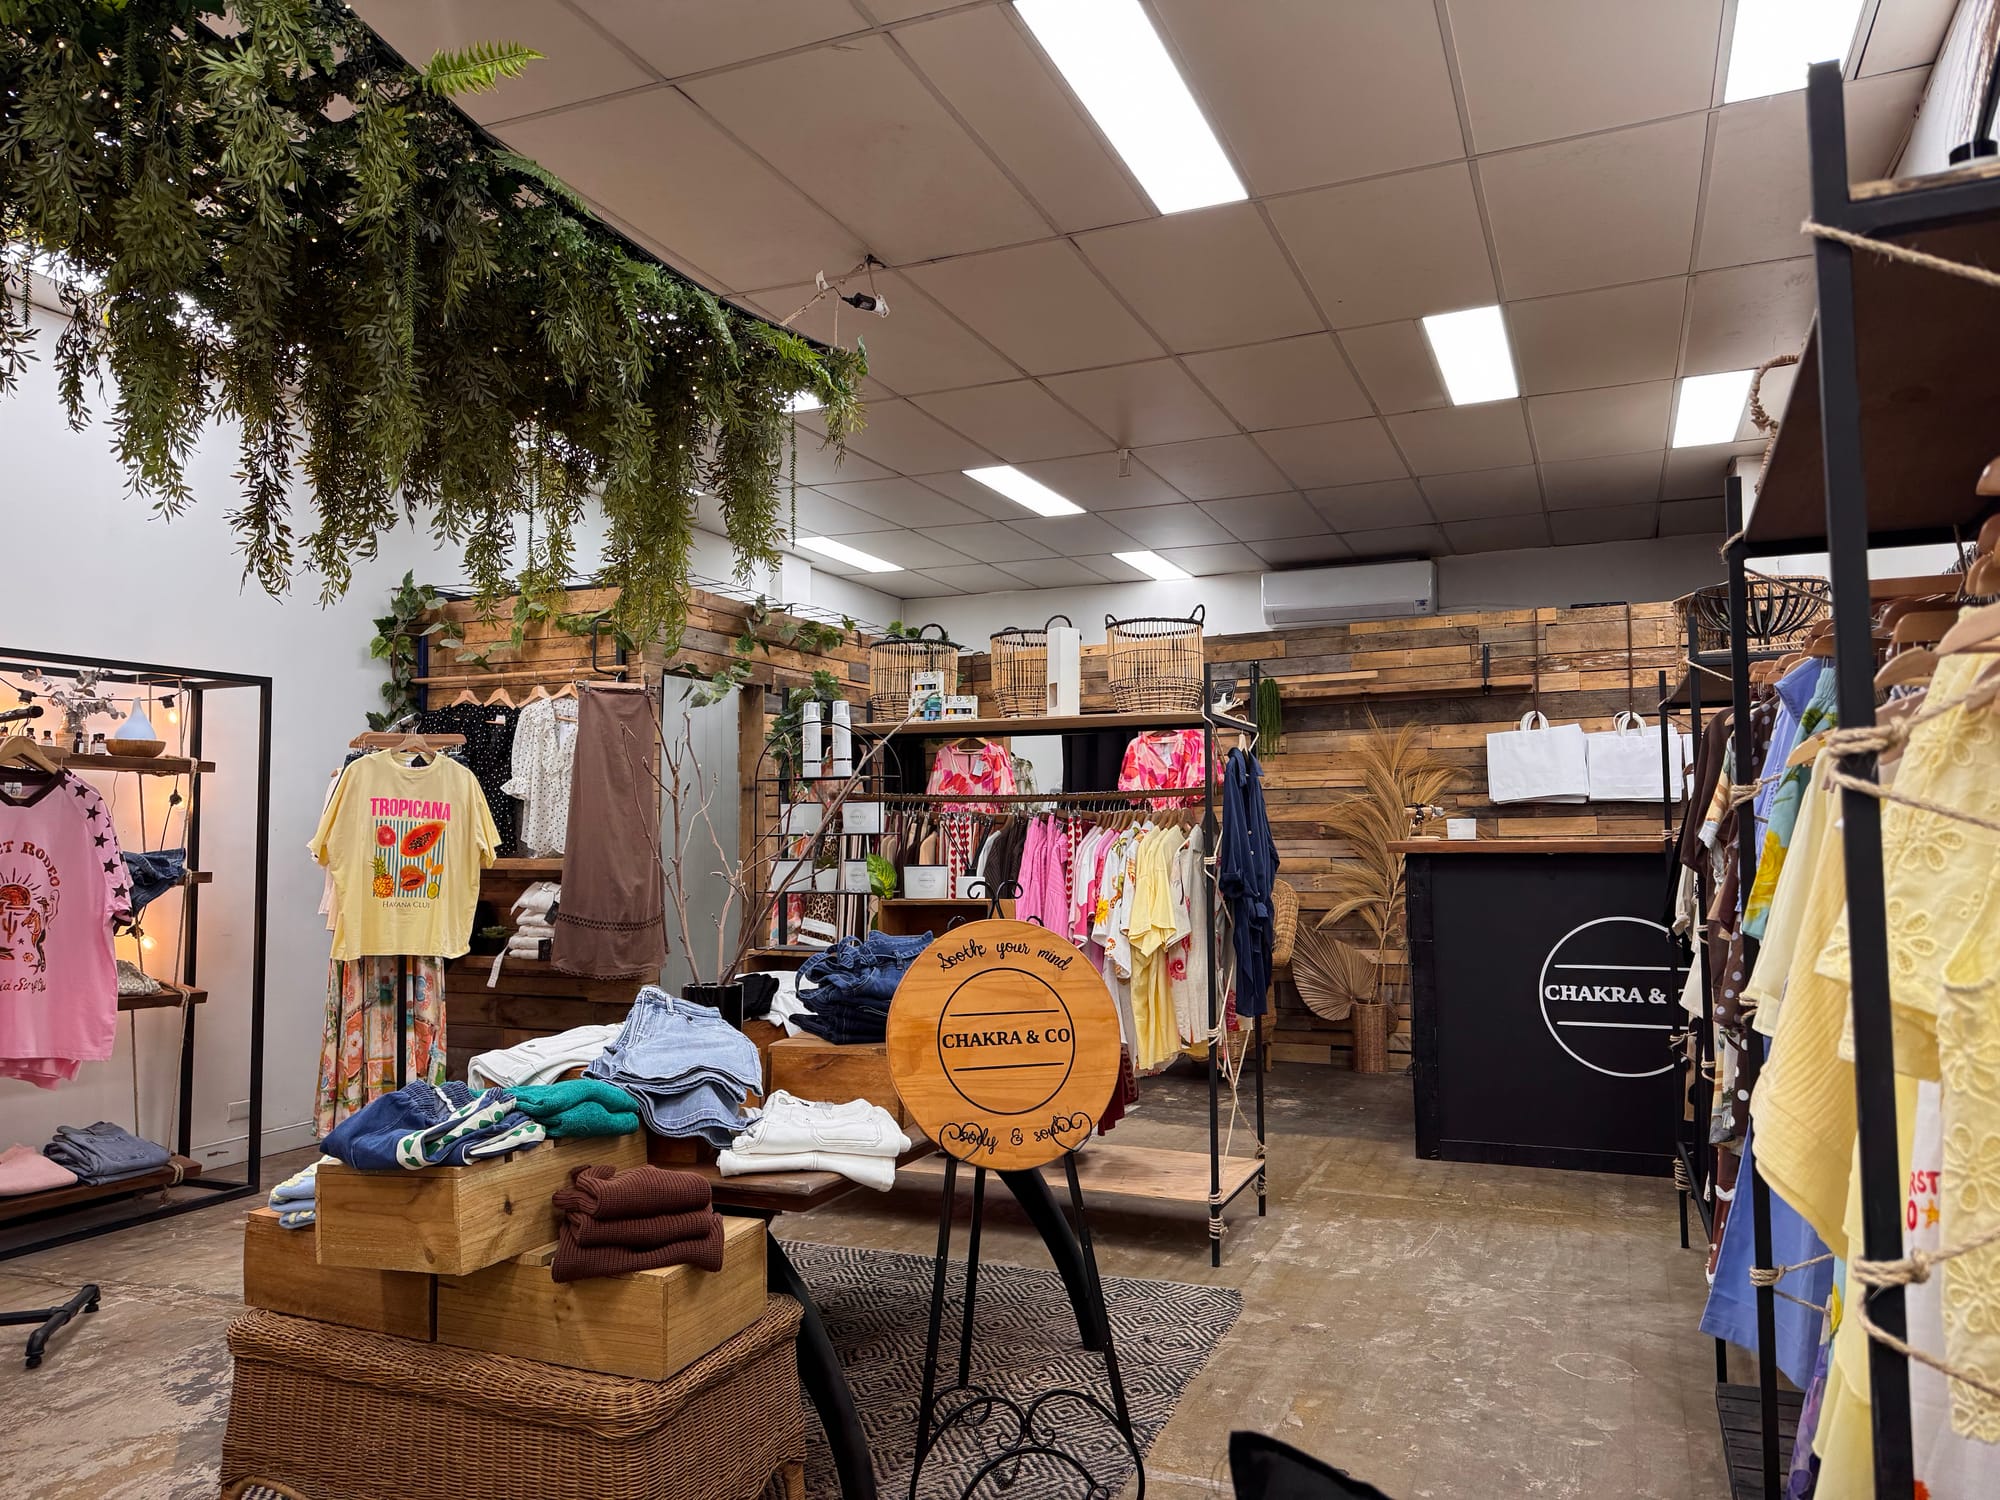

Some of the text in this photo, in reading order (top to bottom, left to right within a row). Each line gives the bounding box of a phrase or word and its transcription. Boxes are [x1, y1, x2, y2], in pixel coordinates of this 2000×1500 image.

[370, 797, 451, 821] TROPICANA
[20, 841, 60, 887] RODEO
[996, 942, 1030, 959] your
[1037, 948, 1073, 971] mind
[1544, 984, 1645, 1003] CHAKRA
[1648, 988, 1668, 1004] &
[942, 1028, 1071, 1049] CHAKRA & CO
[1010, 1127, 1024, 1146] &
